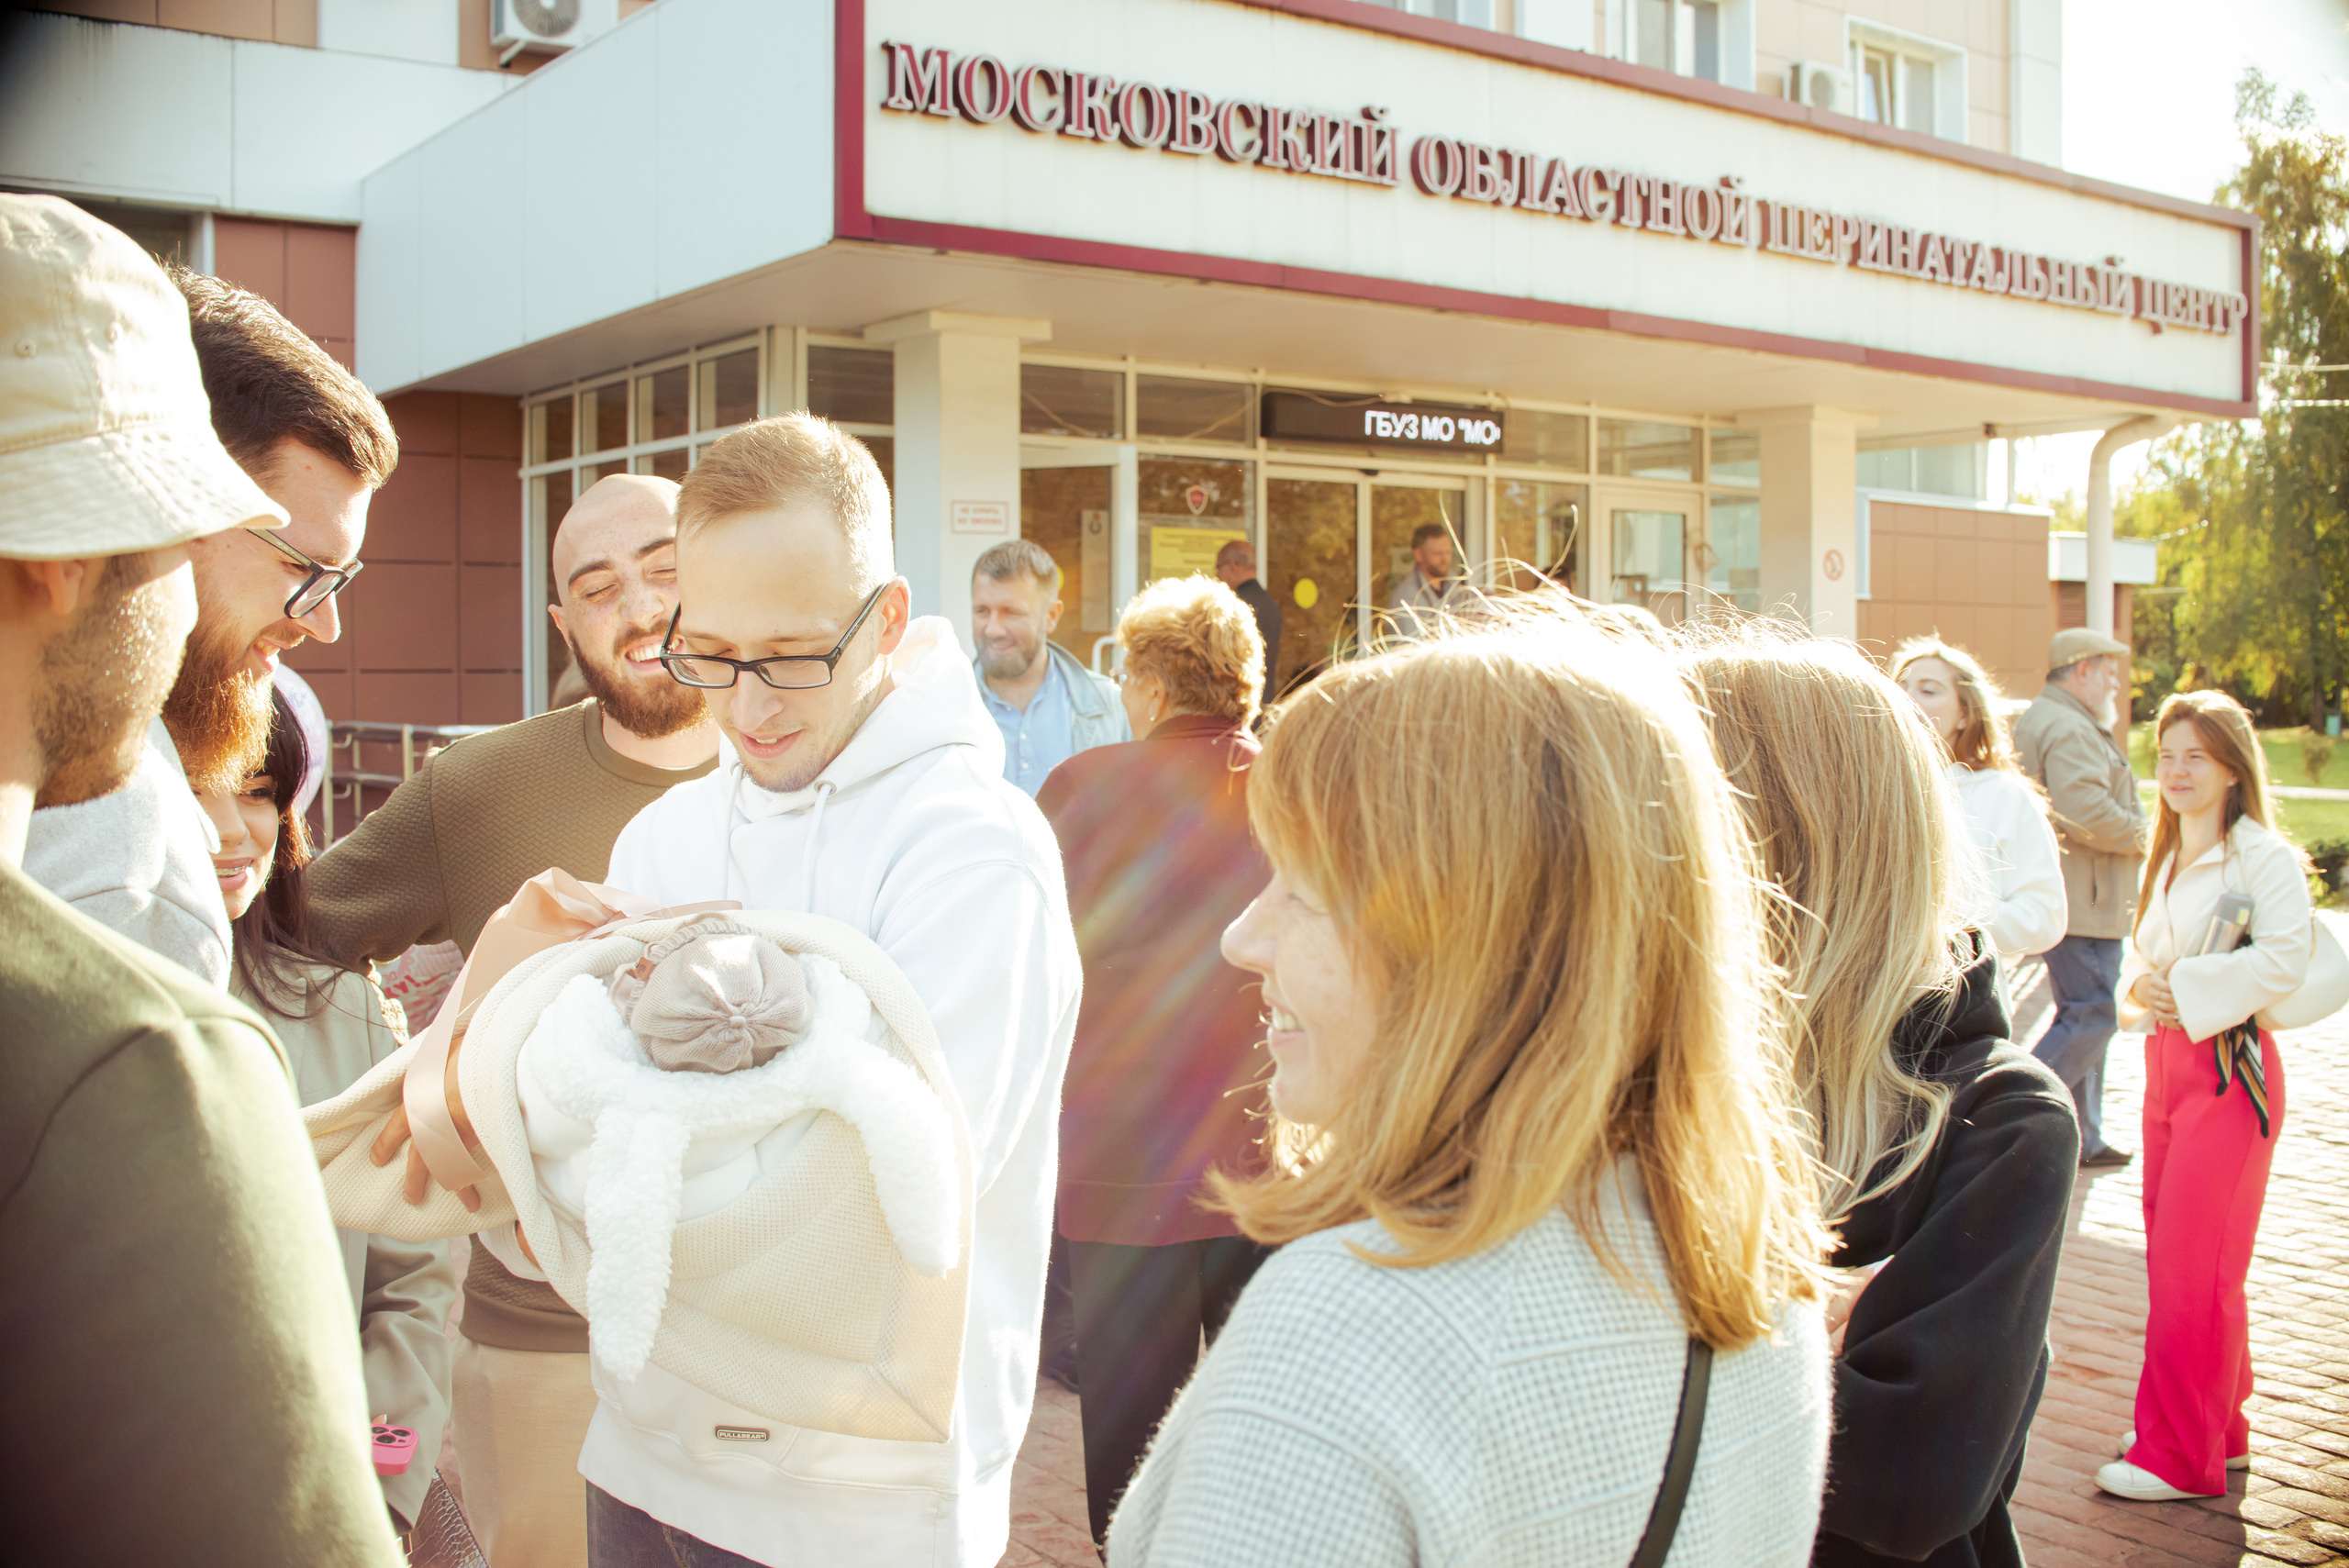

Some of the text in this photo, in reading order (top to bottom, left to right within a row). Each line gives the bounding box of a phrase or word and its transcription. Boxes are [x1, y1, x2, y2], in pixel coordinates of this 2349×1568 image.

[883, 39, 2248, 336] МОСКОВСКИЙ ОБЛАСТНОЙ ПЕРИНАТАЛЬНЫЙ ЦЕНТР
[1364, 409, 1419, 440] ГБУЗ
[1421, 415, 1456, 442] МО
